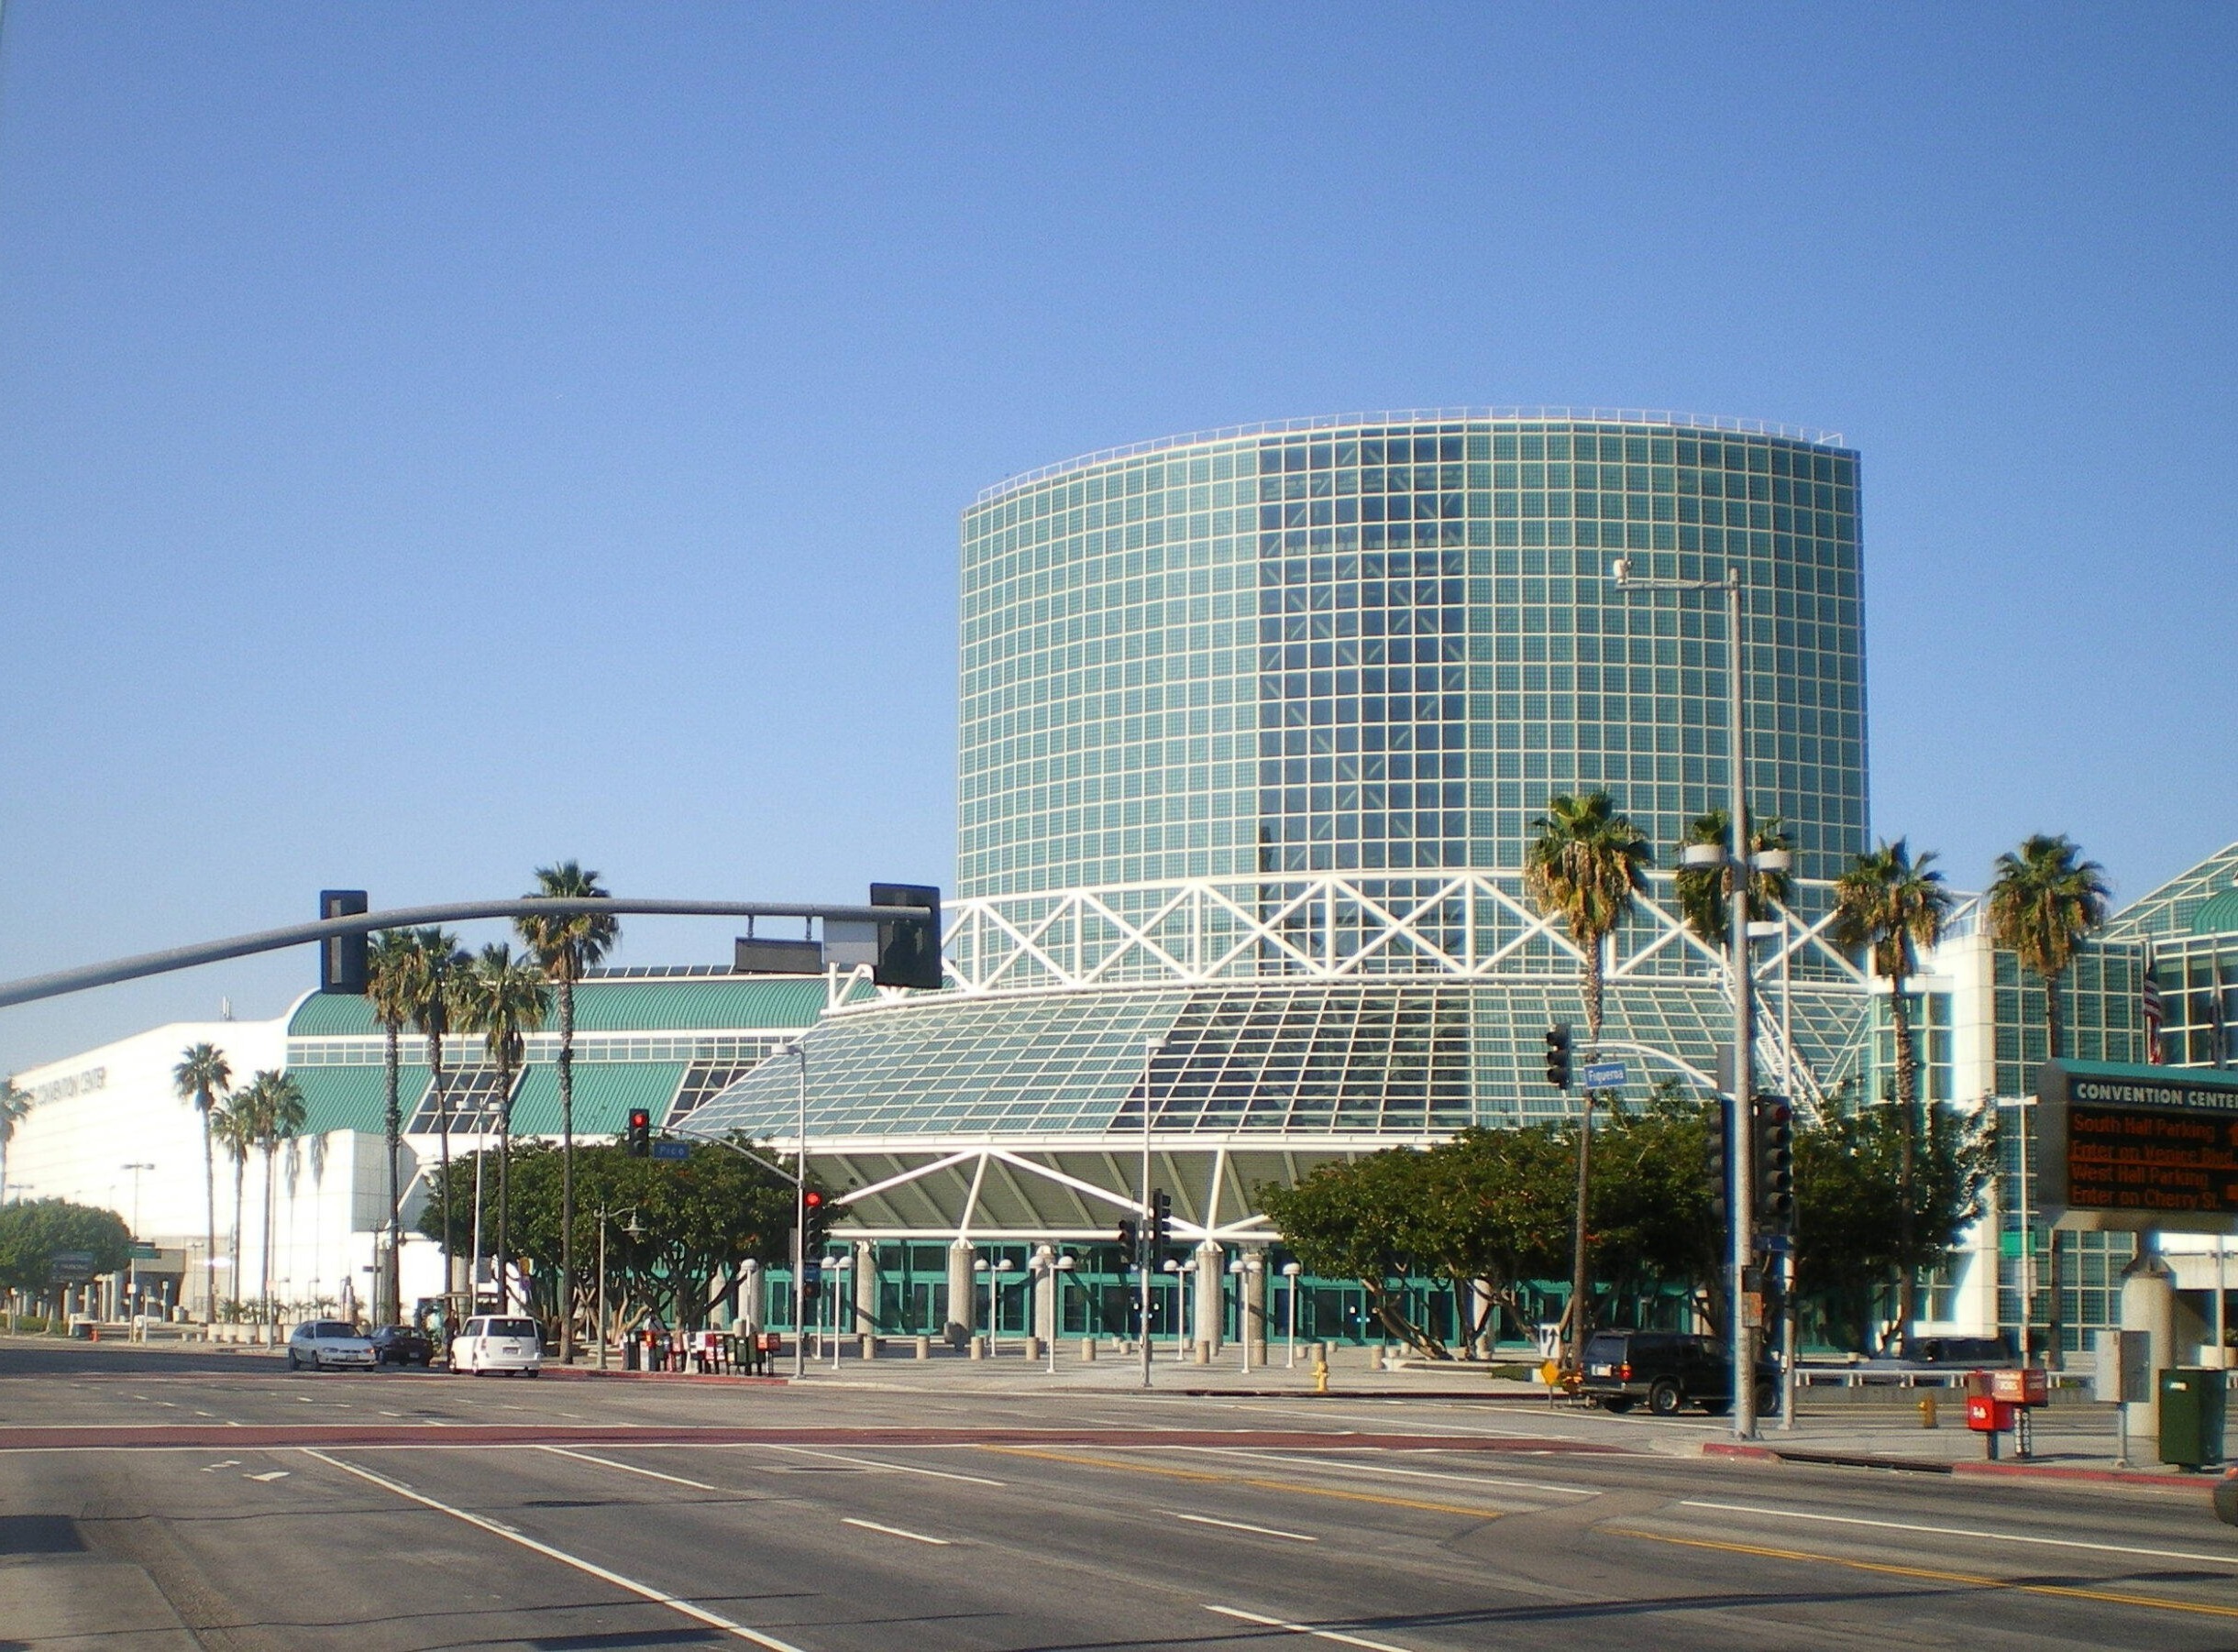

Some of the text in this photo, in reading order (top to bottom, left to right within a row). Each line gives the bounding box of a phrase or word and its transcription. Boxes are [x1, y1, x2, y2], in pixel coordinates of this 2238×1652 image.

[2077, 1084, 2183, 1105] CONVENTION
[2074, 1114, 2215, 1143] South Hall Parking
[2072, 1140, 2112, 1159] Enter
[2120, 1146, 2139, 1160] on
[2072, 1163, 2209, 1191] West Hall Parking
[2072, 1185, 2112, 1204] Enter
[2120, 1191, 2140, 1206] on
[2144, 1188, 2198, 1209] Cherry
